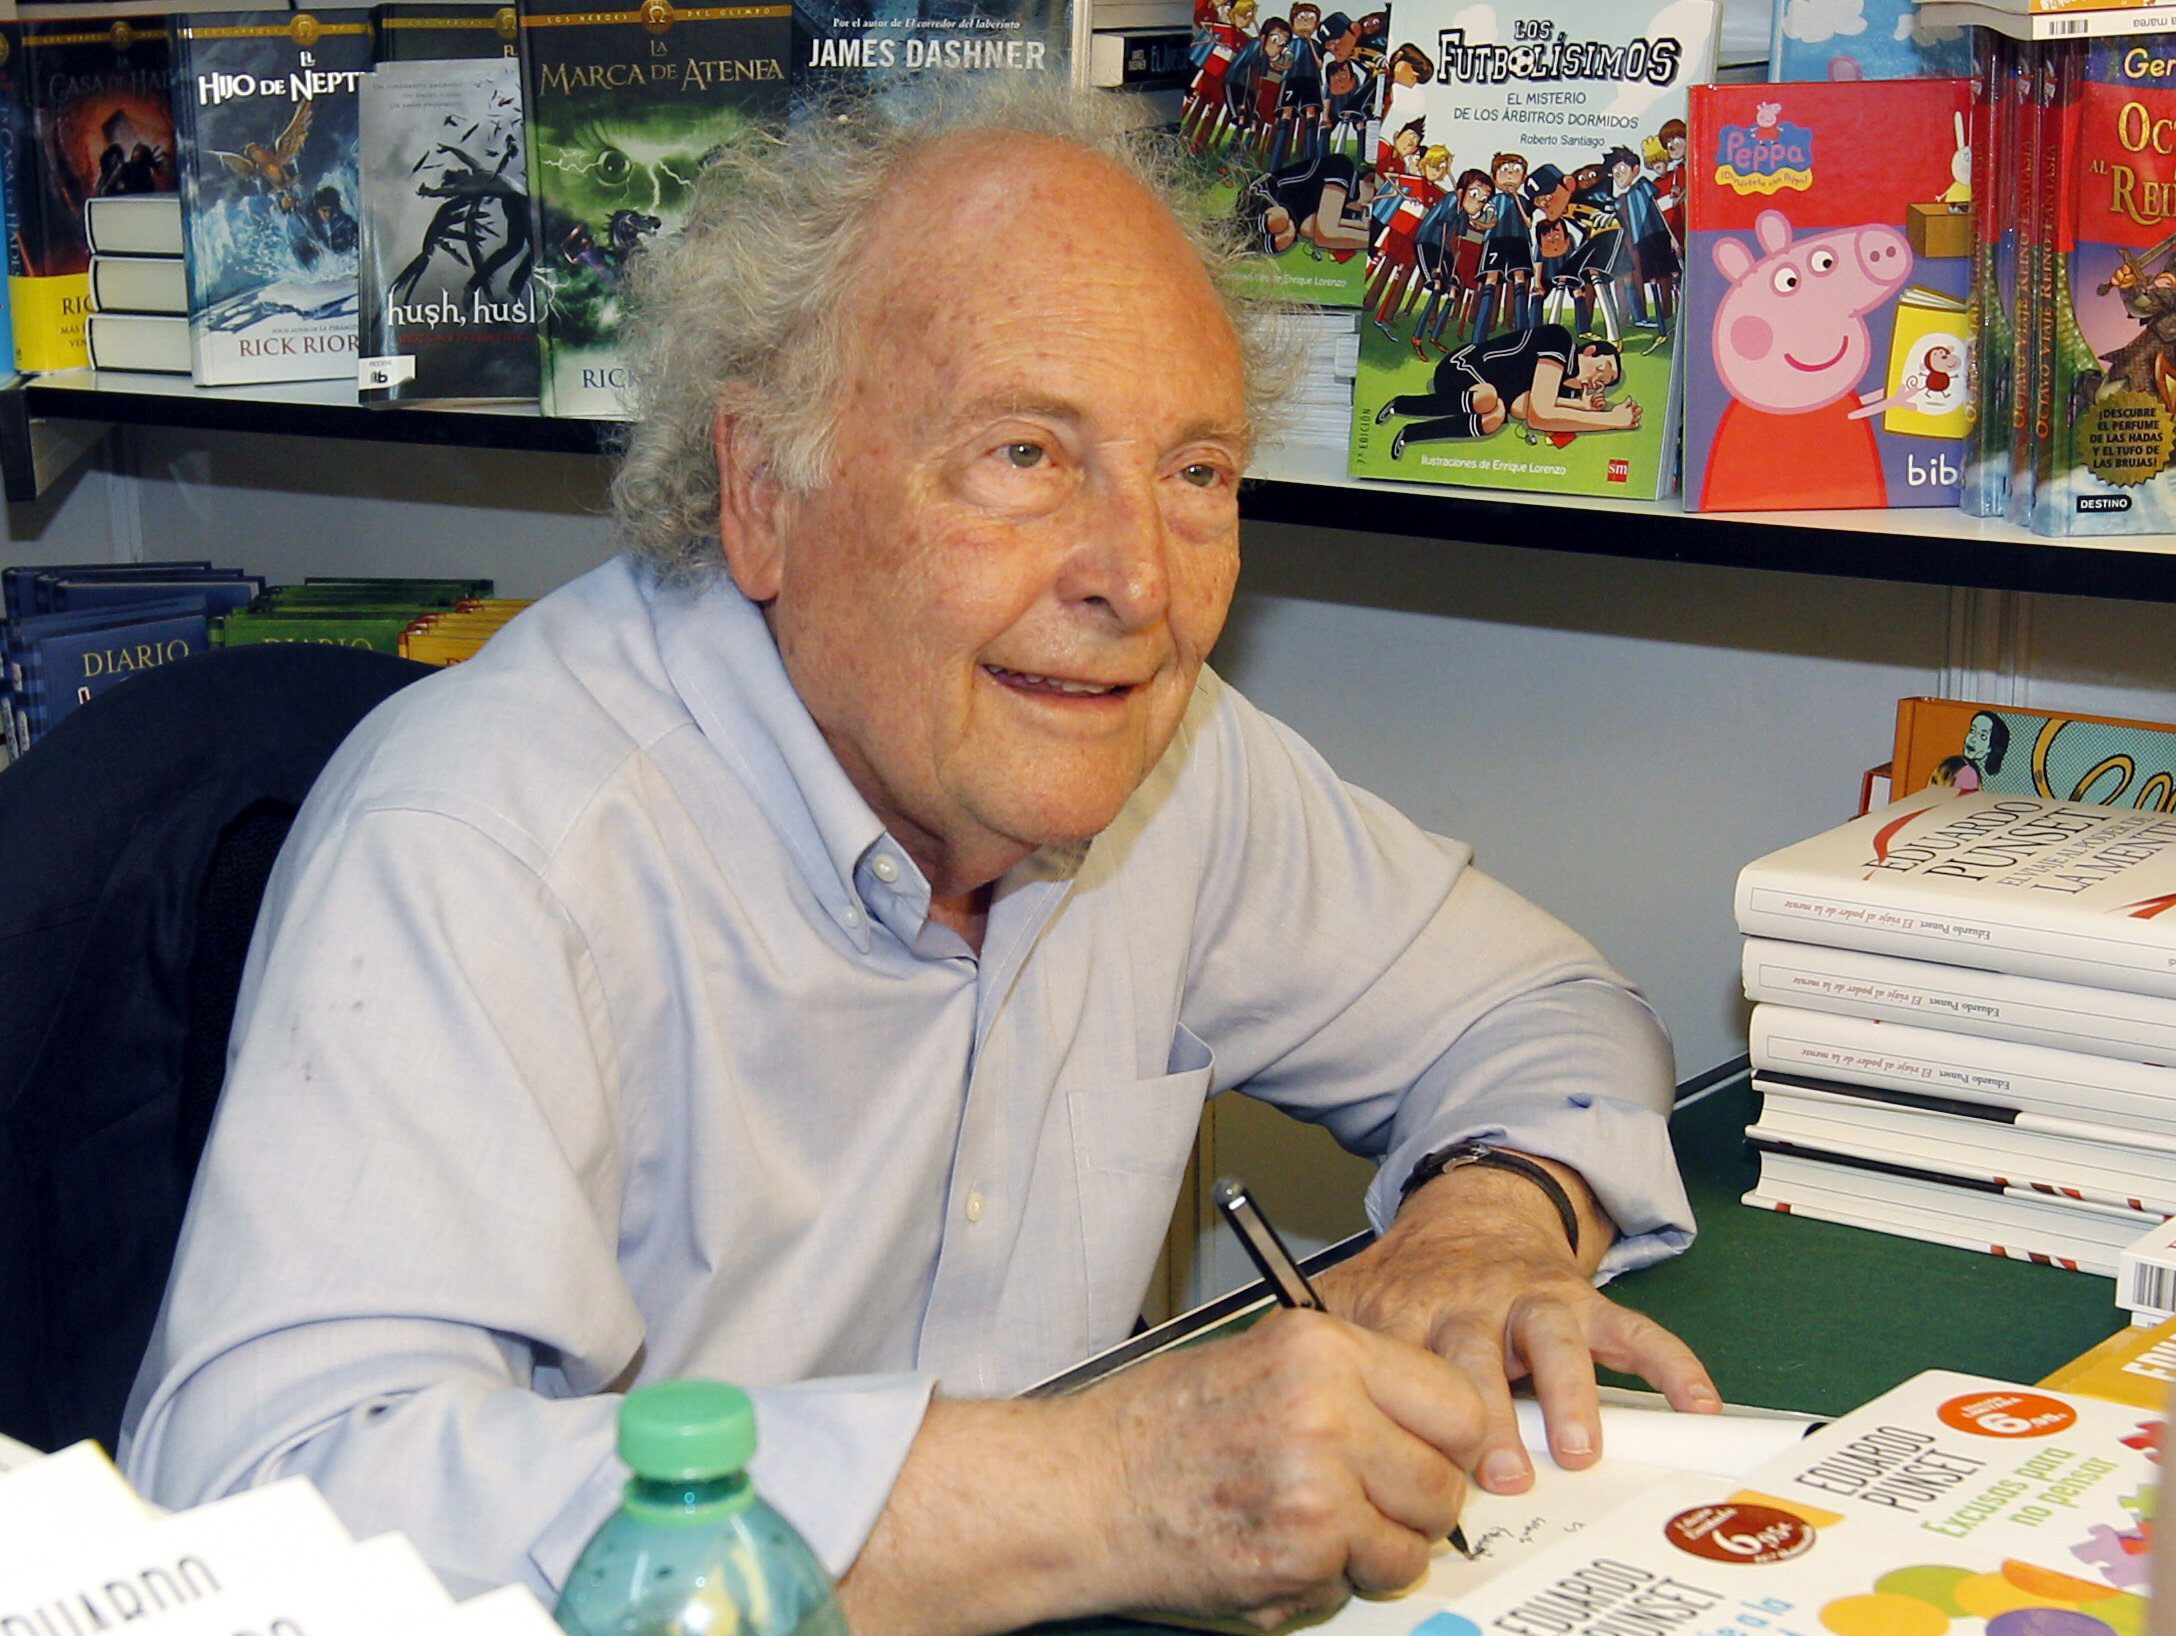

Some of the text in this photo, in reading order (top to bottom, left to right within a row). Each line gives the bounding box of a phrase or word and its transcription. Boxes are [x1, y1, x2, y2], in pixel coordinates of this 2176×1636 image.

[833, 17, 850, 28] Por
[851, 17, 861, 28] el
[862, 19, 888, 29] autor
[890, 18, 902, 29] de
[916, 17, 956, 29] corredor
[958, 18, 974, 29] del
[975, 18, 1021, 30] laberinto
[1514, 20, 1552, 40] LOS
[2133, 15, 2168, 28] marea
[650, 40, 668, 57] LA
[808, 38, 1046, 70] JAMES DASHNER
[198, 72, 256, 105] HIJO
[260, 79, 287, 95] DE
[540, 58, 785, 96] MARCA DE ATENEA
[1507, 92, 1587, 105] EL MISTERIO
[1454, 106, 1639, 129] DE LOS ÁRBITROS DORMIDOS
[1520, 133, 1605, 148] Roberto Santiago
[1726, 130, 1805, 171] Peppa
[388, 284, 466, 330] hush,
[239, 337, 296, 357] RICK
[2090, 432, 2163, 443] DE LAS HADAS
[2097, 420, 2159, 431] EL PERFUME
[1421, 454, 1567, 476] Ilustraciones de Enrique Lorenzo
[2092, 445, 2159, 456] Y EL TUFO DE
[2093, 457, 2158, 468] LAS BRUJAS!
[2080, 499, 2129, 509] DESTINO
[81, 639, 190, 678] DIARIO
[1863, 801, 2044, 873] EDUARDO
[1922, 807, 2113, 882] PUNSET
[2031, 873, 2109, 895] LA
[1784, 900, 1991, 940] Eduardo Punset El viaje al poder de la mente
[1793, 976, 2000, 1017] Eduardo Punset El viaje al poder de la mente
[1801, 1049, 2010, 1090] Eduardo Punset El viaje al poder de la mente
[1795, 1425, 1936, 1497] EDUARDO
[1860, 1448, 1988, 1514] PUNSET
[1921, 1446, 2077, 1540] Excusas para
[2008, 1456, 2120, 1528] no pensar
[1492, 1557, 1654, 1635] EDUARDO
